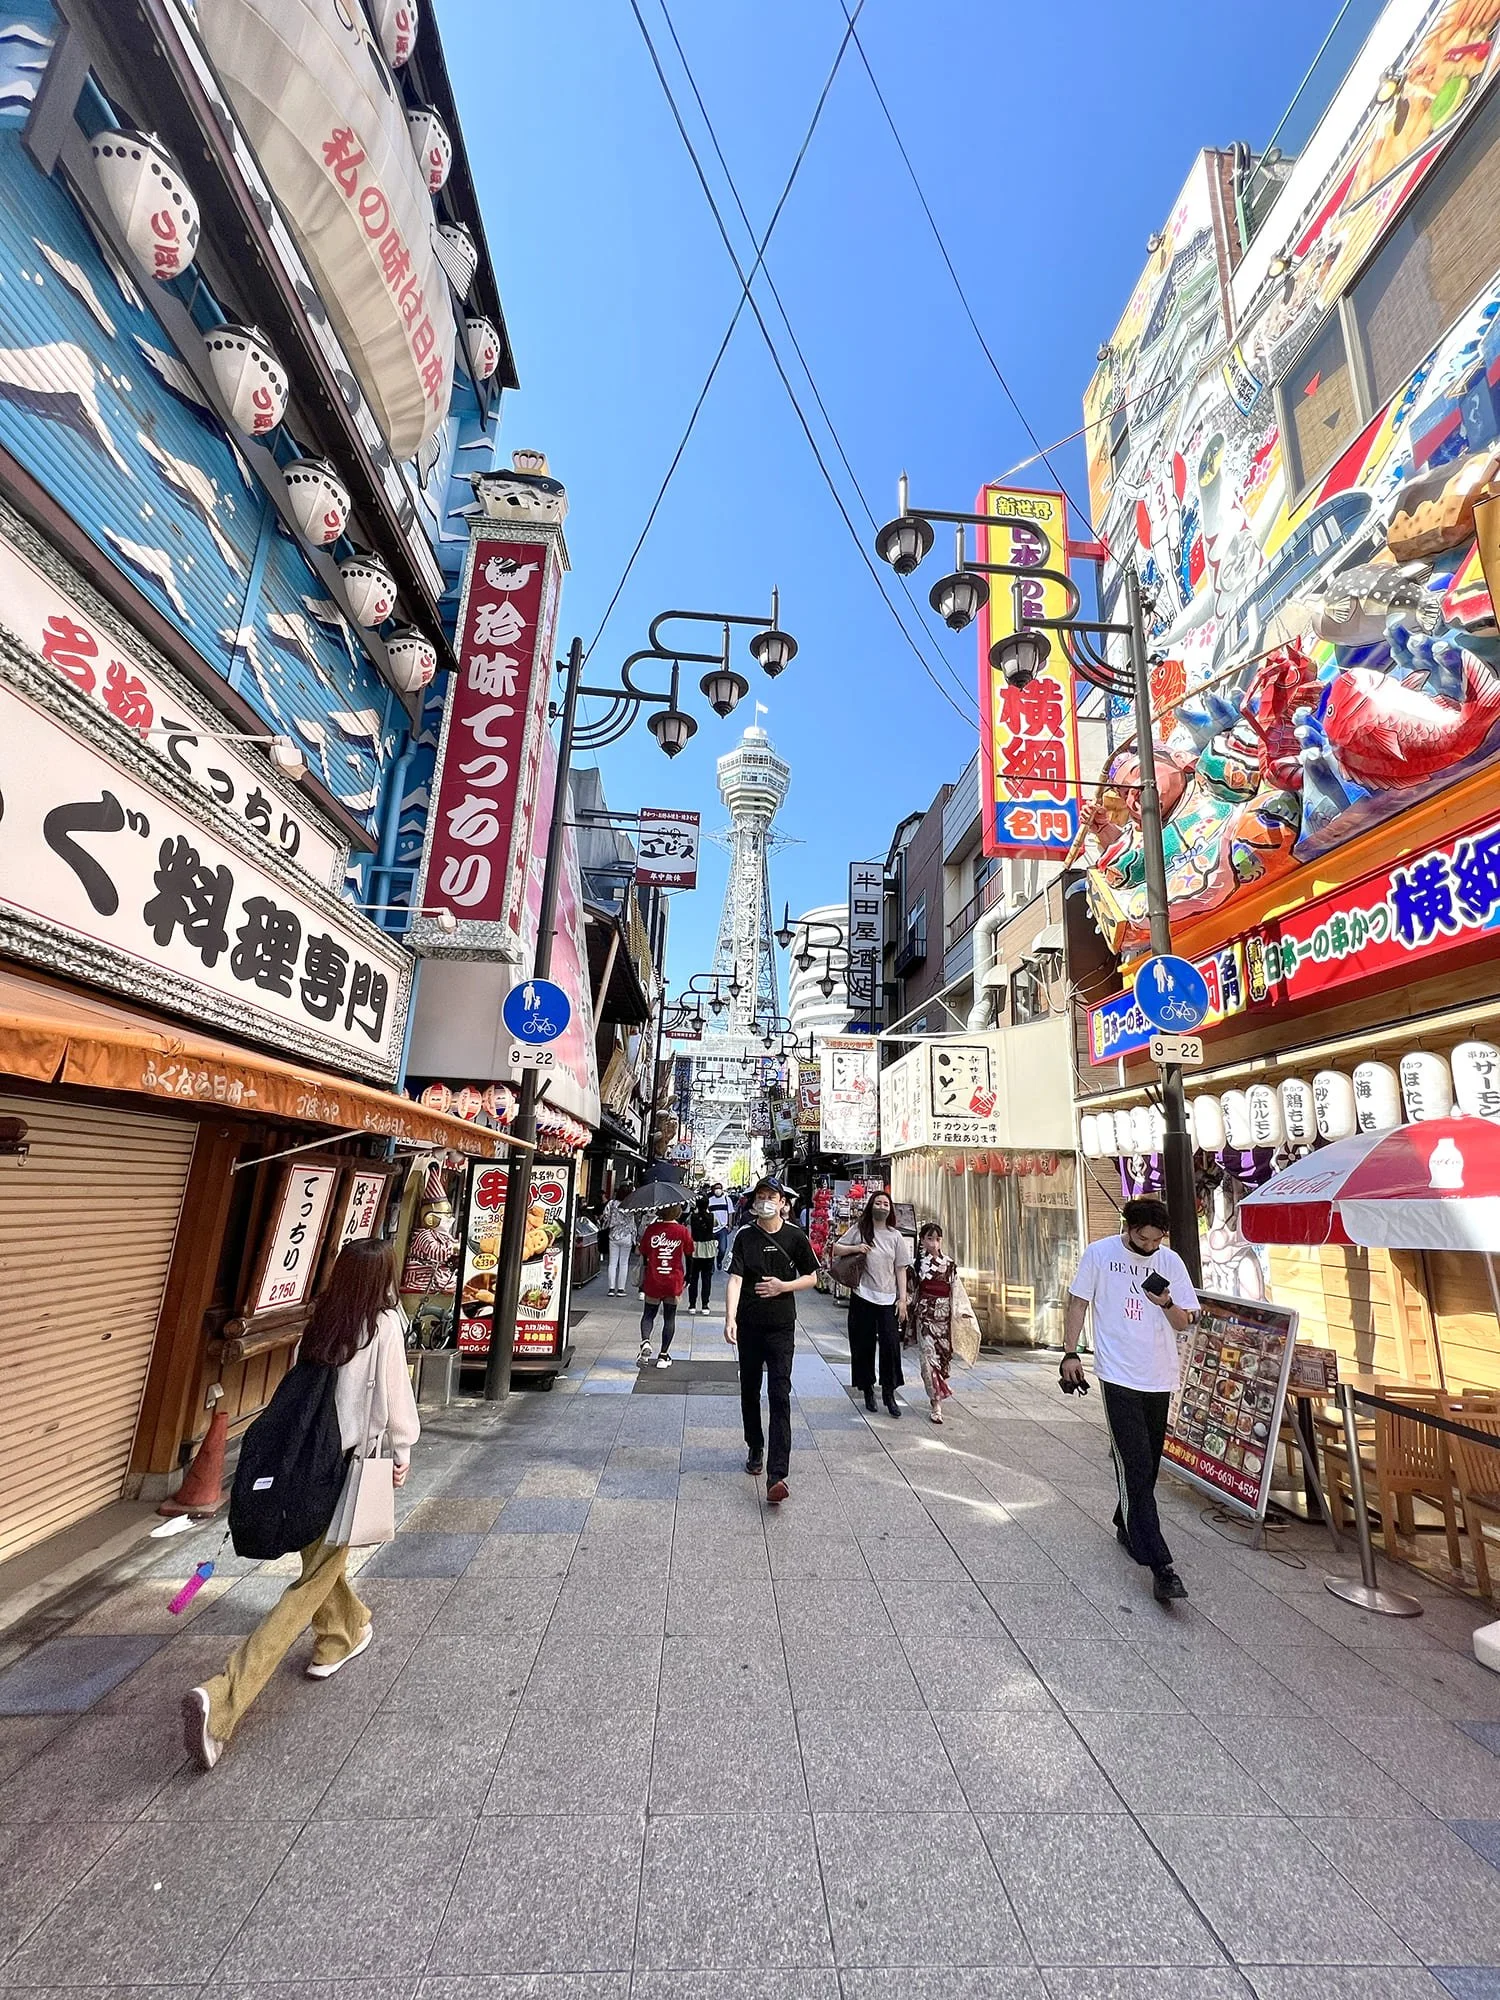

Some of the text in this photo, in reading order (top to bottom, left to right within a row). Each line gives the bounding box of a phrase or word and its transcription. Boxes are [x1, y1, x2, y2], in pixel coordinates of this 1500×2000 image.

[321, 127, 441, 412] 私の味は日本一
[996, 497, 1052, 520] 新世界
[440, 603, 528, 906] 珍味てっちり
[999, 678, 1067, 802] 横綱
[640, 838, 695, 860] エビス
[1007, 809, 1070, 840] 名門
[0, 786, 389, 1042] ぐ料理専門
[851, 872, 882, 1001] 半田屋酒店
[1266, 906, 1389, 981] 日本一の串かつ
[1220, 953, 1241, 1010] 名門
[1249, 939, 1266, 999] 新世界
[142, 1061, 257, 1105] ふぐなら日本一
[1356, 1080, 1377, 1130] 海老
[1404, 1072, 1424, 1122] ほたて
[945, 1123, 997, 1132] カウンター席
[1253, 1099, 1271, 1140] ホルモン
[1286, 1093, 1305, 1137] 鶏もも
[283, 1176, 320, 1271] てっちり
[1129, 1281, 1140, 1294] &
